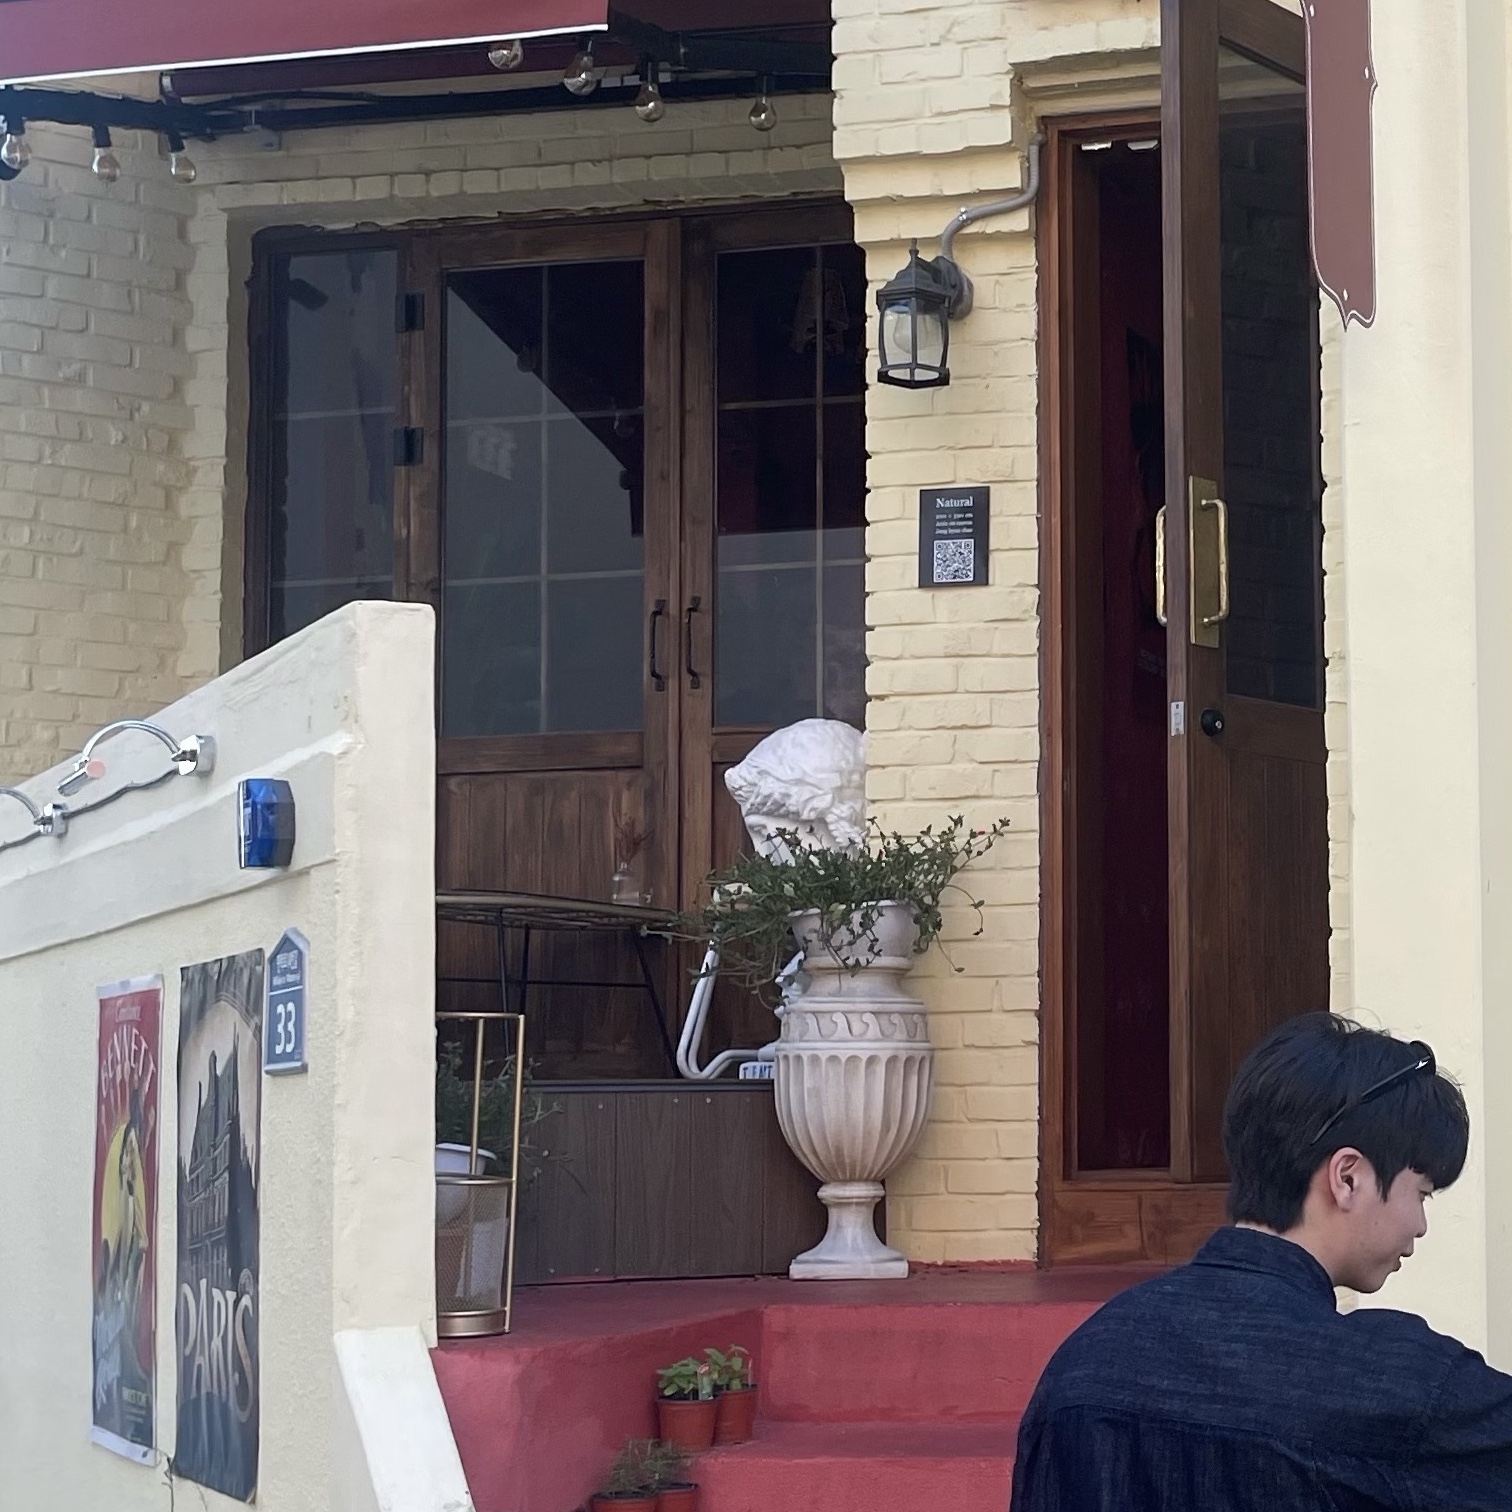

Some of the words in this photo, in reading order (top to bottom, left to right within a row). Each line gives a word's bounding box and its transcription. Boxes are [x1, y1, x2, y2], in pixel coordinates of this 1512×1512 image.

[935, 495, 974, 509] Natural
[275, 1002, 296, 1055] 33
[100, 1024, 157, 1100] BENNETT
[178, 1276, 254, 1424] PARIS
